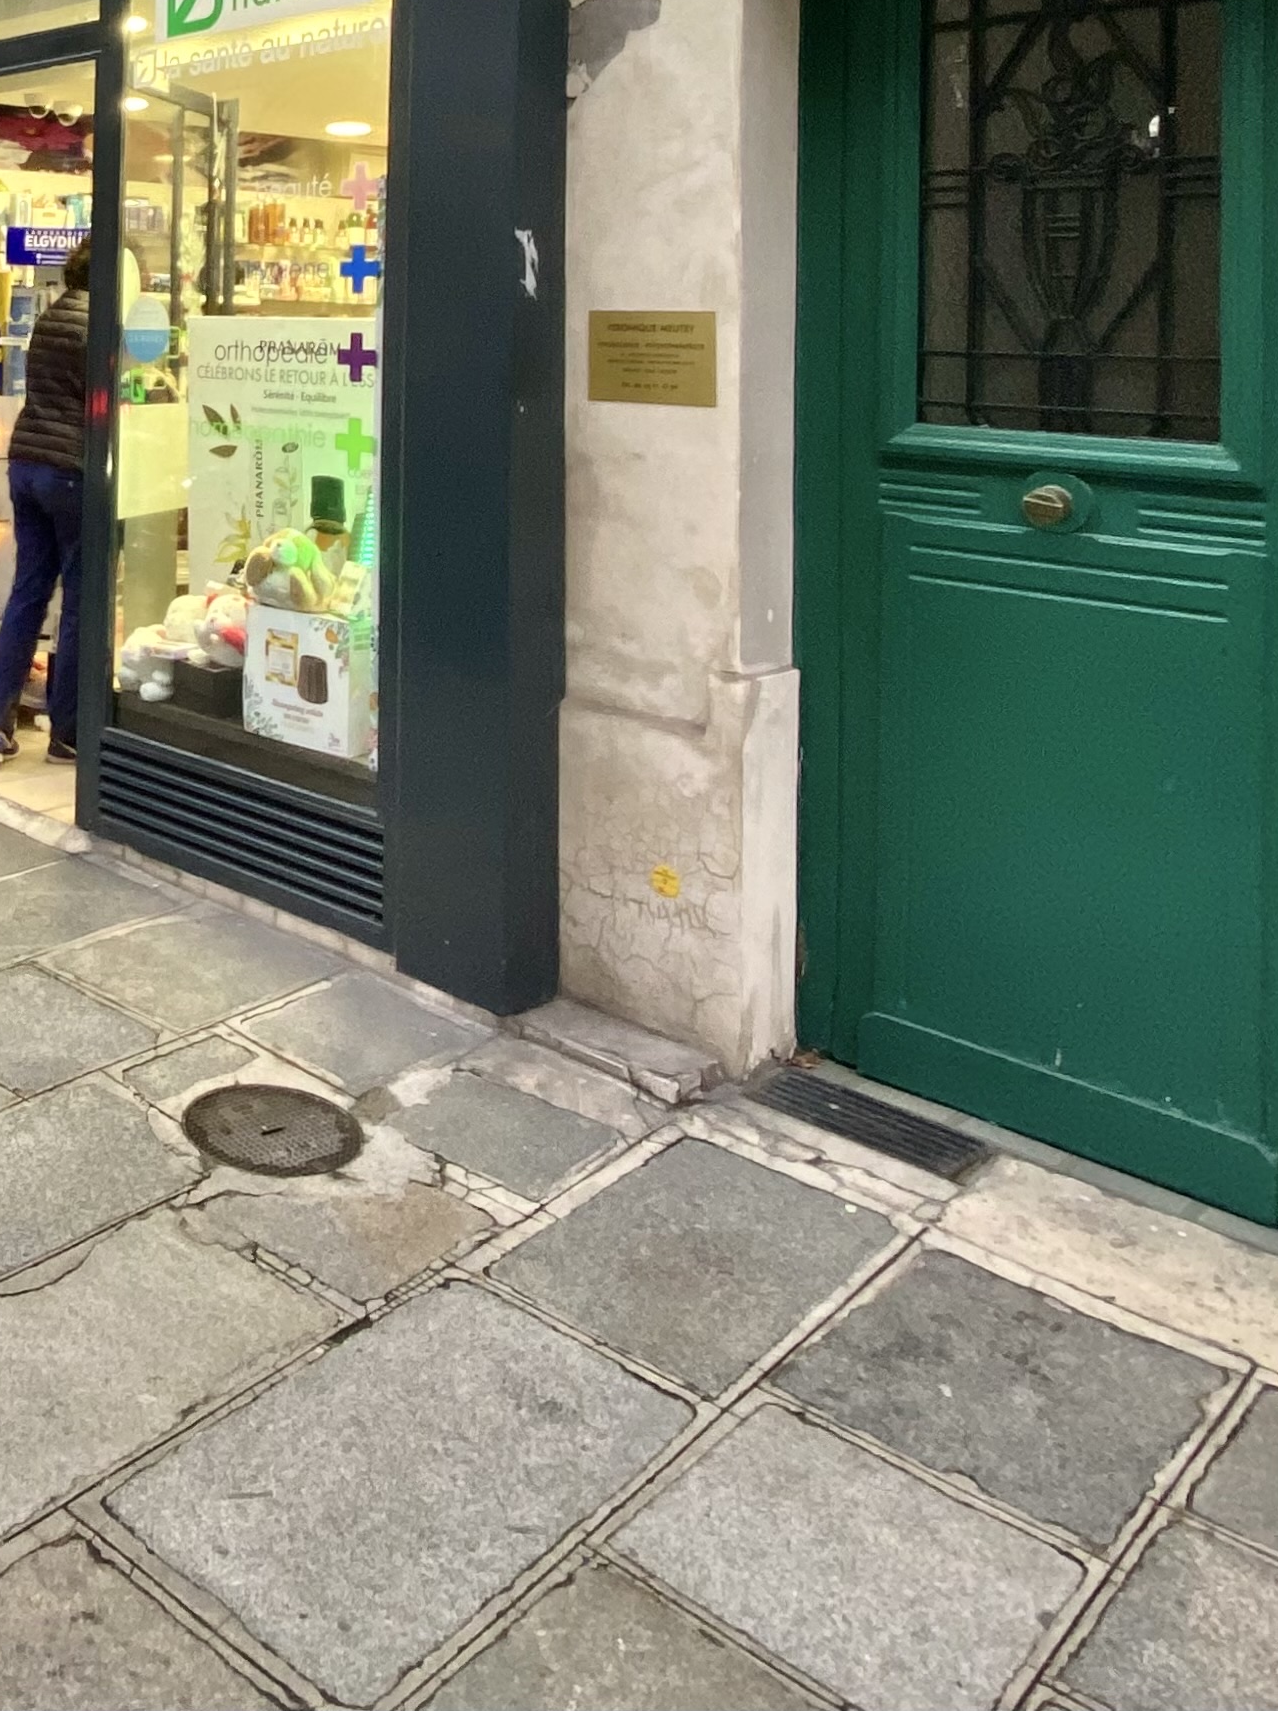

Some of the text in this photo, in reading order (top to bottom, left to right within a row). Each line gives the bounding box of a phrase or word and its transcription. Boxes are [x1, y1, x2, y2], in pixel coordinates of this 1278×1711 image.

[259, 35, 291, 64] au
[25, 234, 83, 249] ELGYDIU
[215, 339, 328, 367] orthopédie
[265, 368, 278, 383] LE
[279, 369, 327, 386] RETOUR
